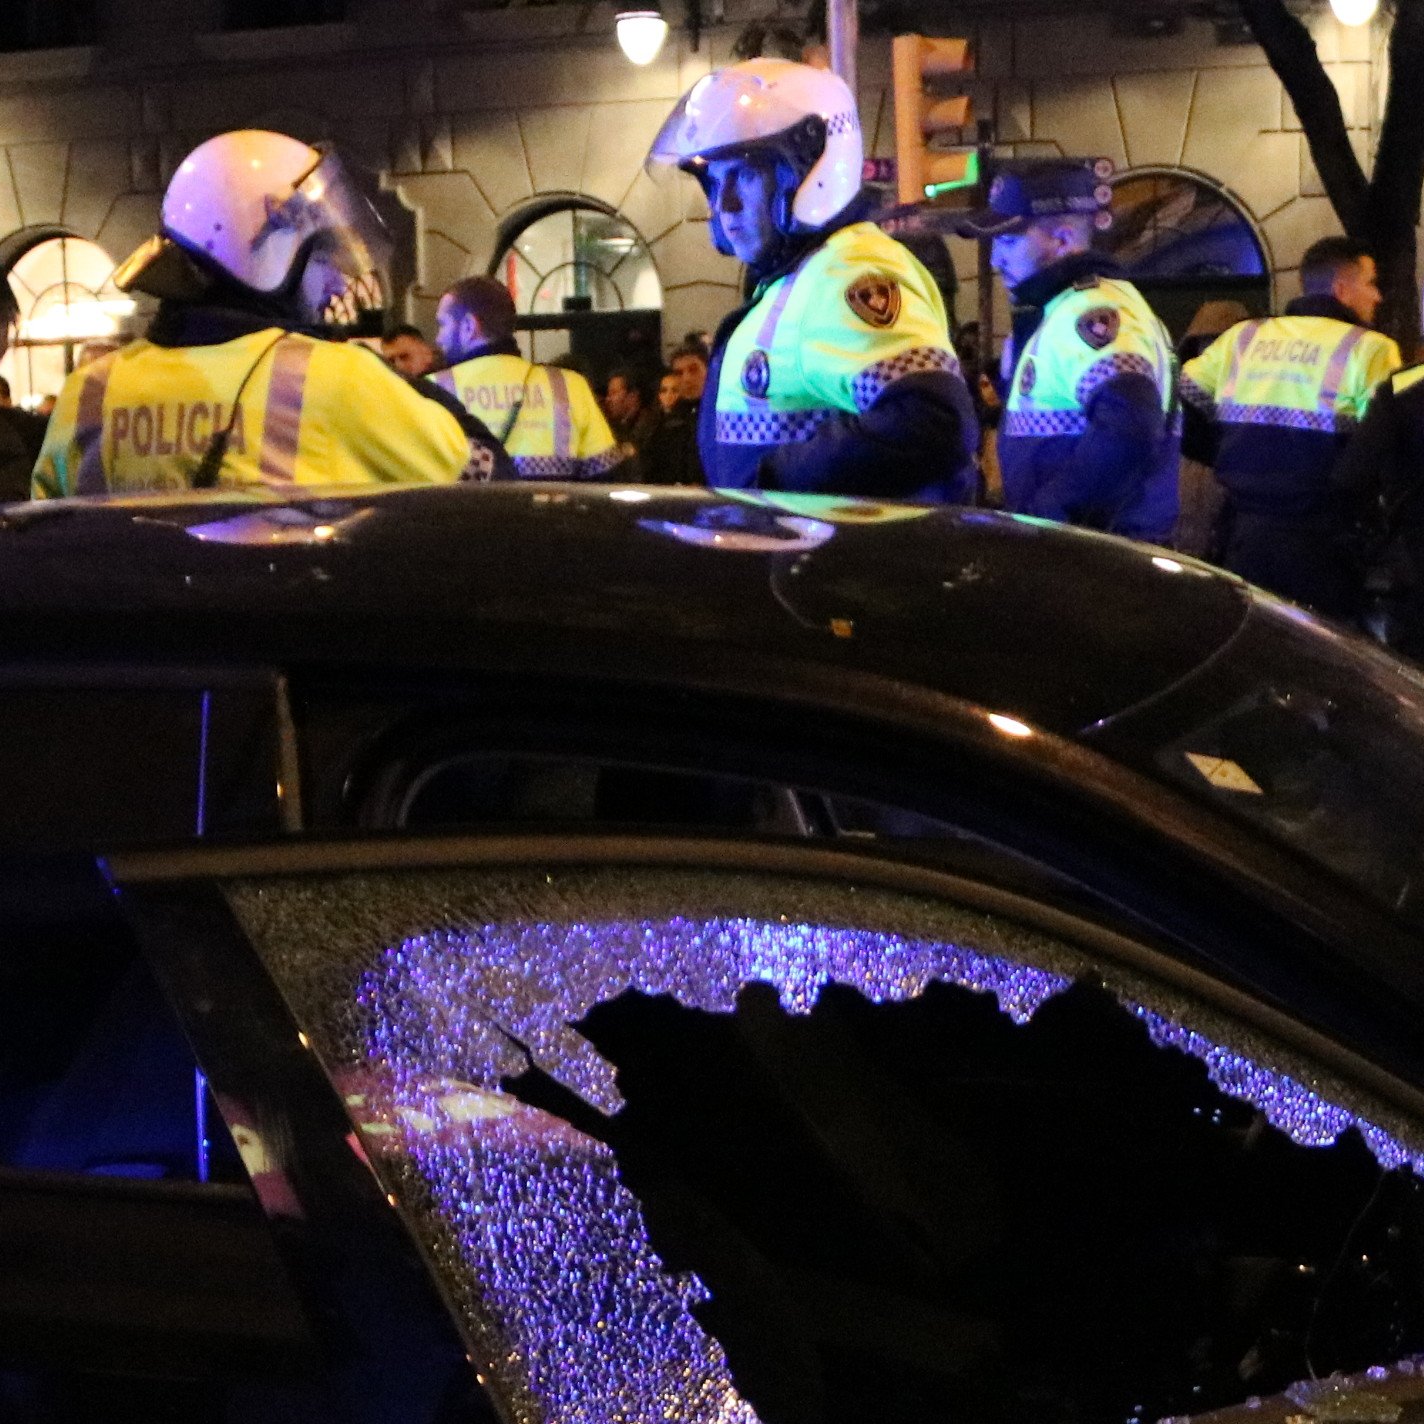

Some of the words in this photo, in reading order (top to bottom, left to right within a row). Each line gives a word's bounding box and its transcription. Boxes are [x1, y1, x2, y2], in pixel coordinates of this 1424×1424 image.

[1250, 338, 1321, 366] POLICIA
[464, 383, 547, 411] POLICIA
[112, 401, 246, 458] POLICIA
